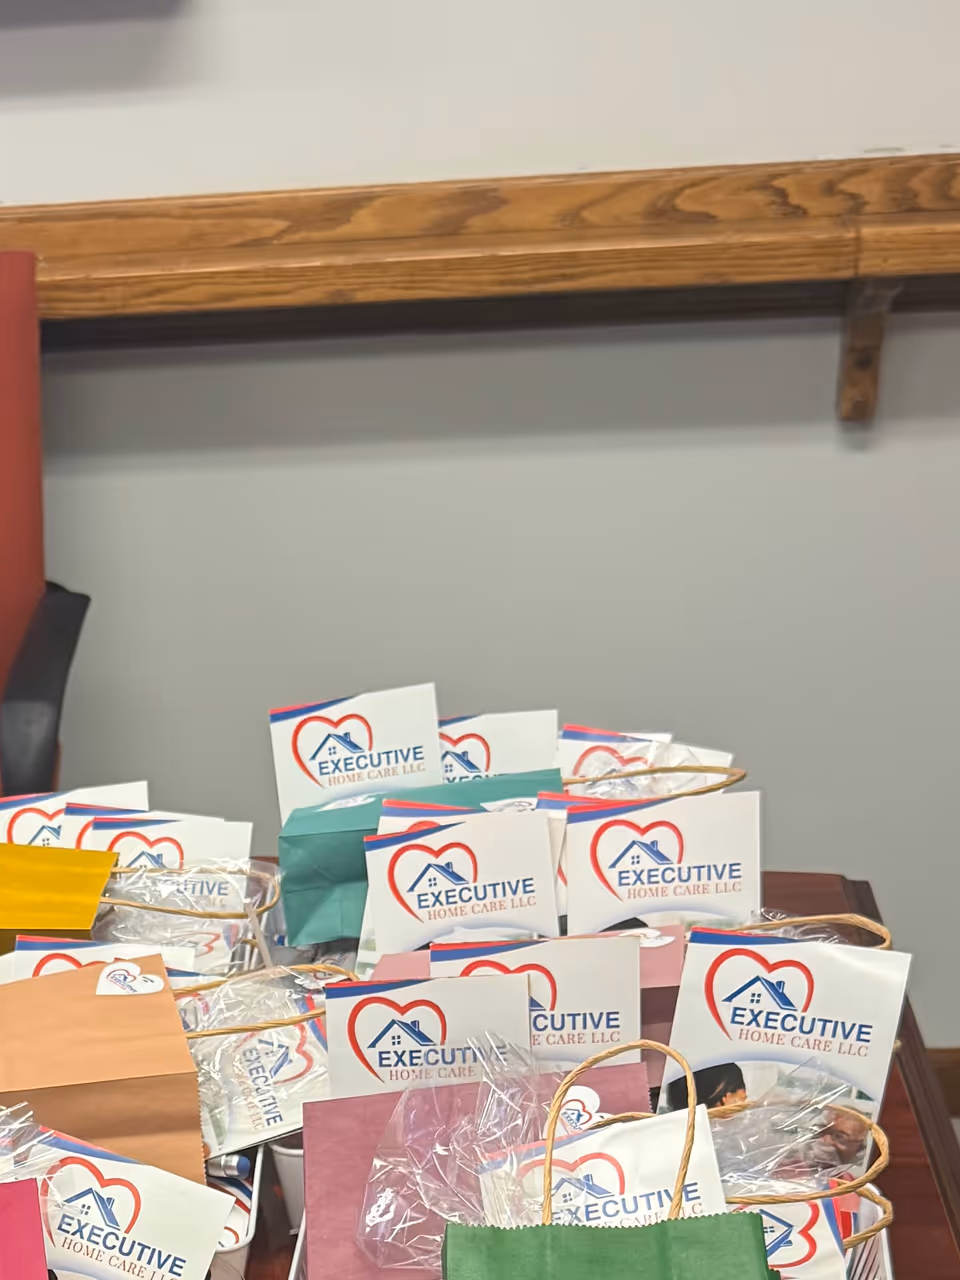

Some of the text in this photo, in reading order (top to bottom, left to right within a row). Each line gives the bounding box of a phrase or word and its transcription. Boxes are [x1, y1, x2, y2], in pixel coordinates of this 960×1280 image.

[318, 746, 424, 776] EXECUTIVE
[328, 763, 426, 787] HOME CARE LLC
[618, 862, 742, 887] EXECUTIVE
[417, 877, 536, 909] EXECUTIVE
[627, 882, 742, 899] HOME CARE LLC
[428, 896, 536, 921] HOME CARE LLC
[533, 1011, 621, 1032] CUTIVE
[730, 1006, 873, 1043] EXECUTIVE
[546, 1033, 587, 1046] CARE
[592, 1030, 621, 1044] LLC
[738, 1028, 870, 1058] HOME CARE LLC
[378, 1043, 507, 1068] EXECUTIE
[389, 1066, 477, 1081] HOME CARE
[57, 1214, 186, 1277] EXECUTIVE
[61, 1236, 106, 1262] HOME
[108, 1255, 147, 1279] CARE
